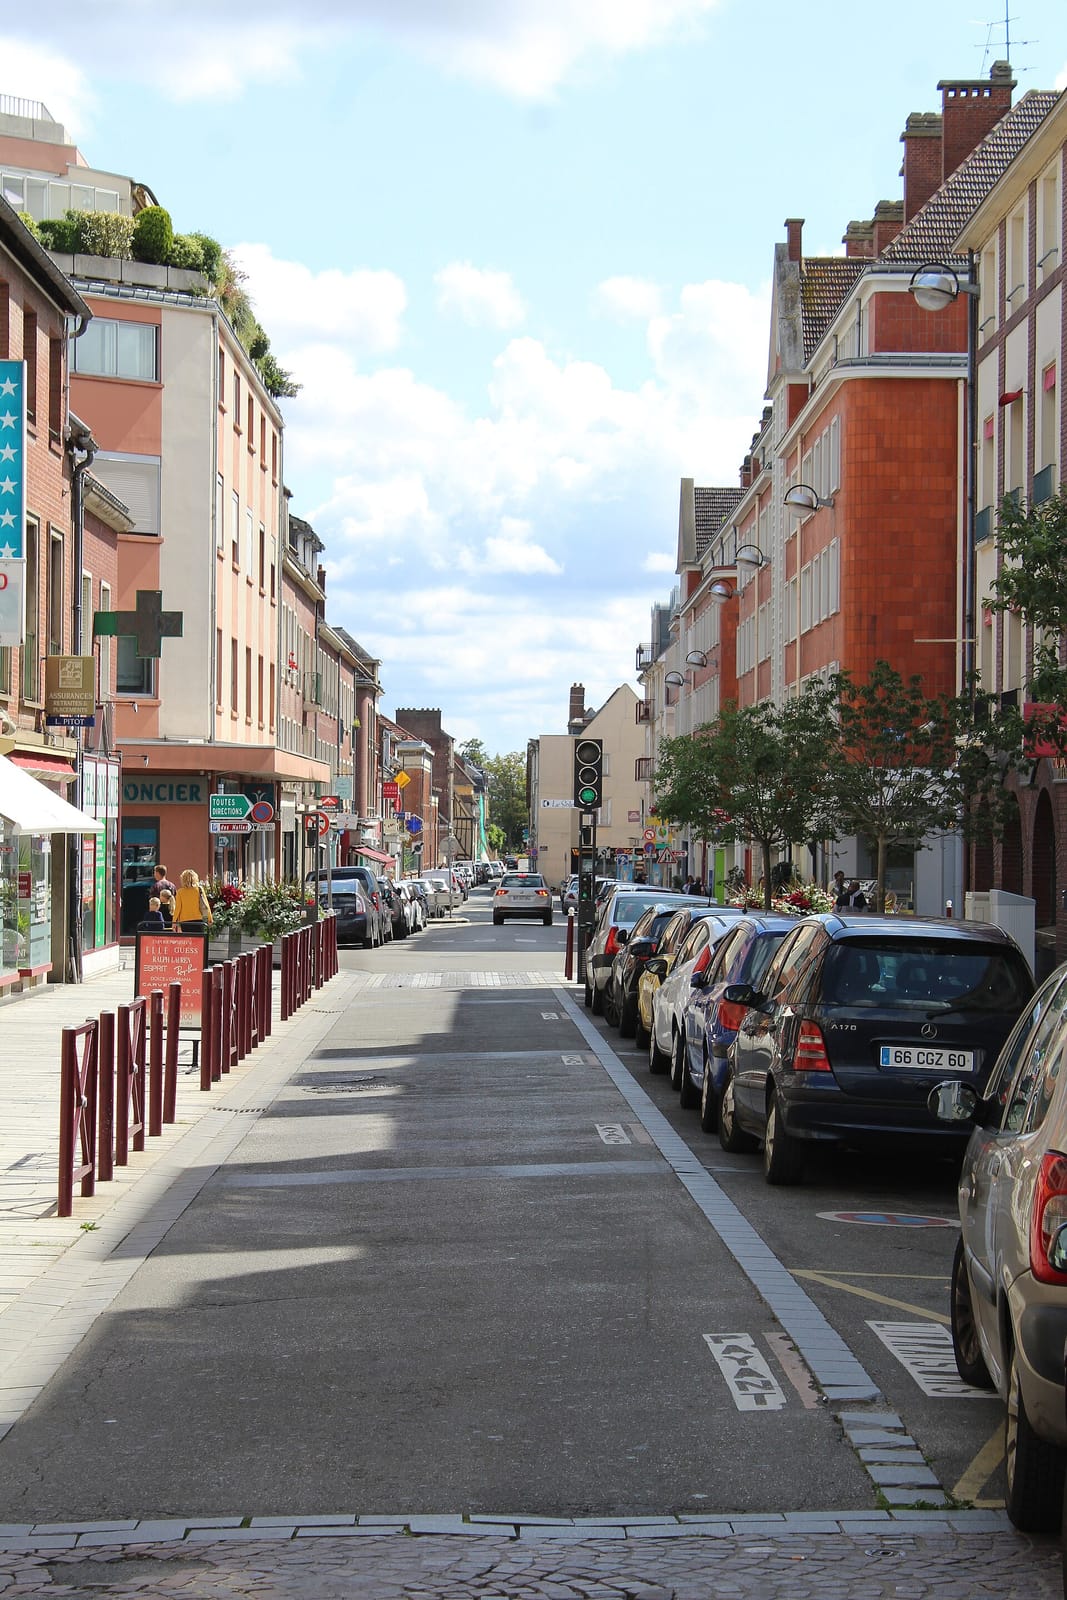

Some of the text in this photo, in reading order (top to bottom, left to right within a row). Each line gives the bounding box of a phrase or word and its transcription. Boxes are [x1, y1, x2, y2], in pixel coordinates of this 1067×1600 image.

[212, 798, 236, 806] TOUTES
[212, 807, 243, 815] DIRECTIONS
[145, 946, 169, 955] ELLE
[894, 1050, 966, 1067] 66 CGZ 60
